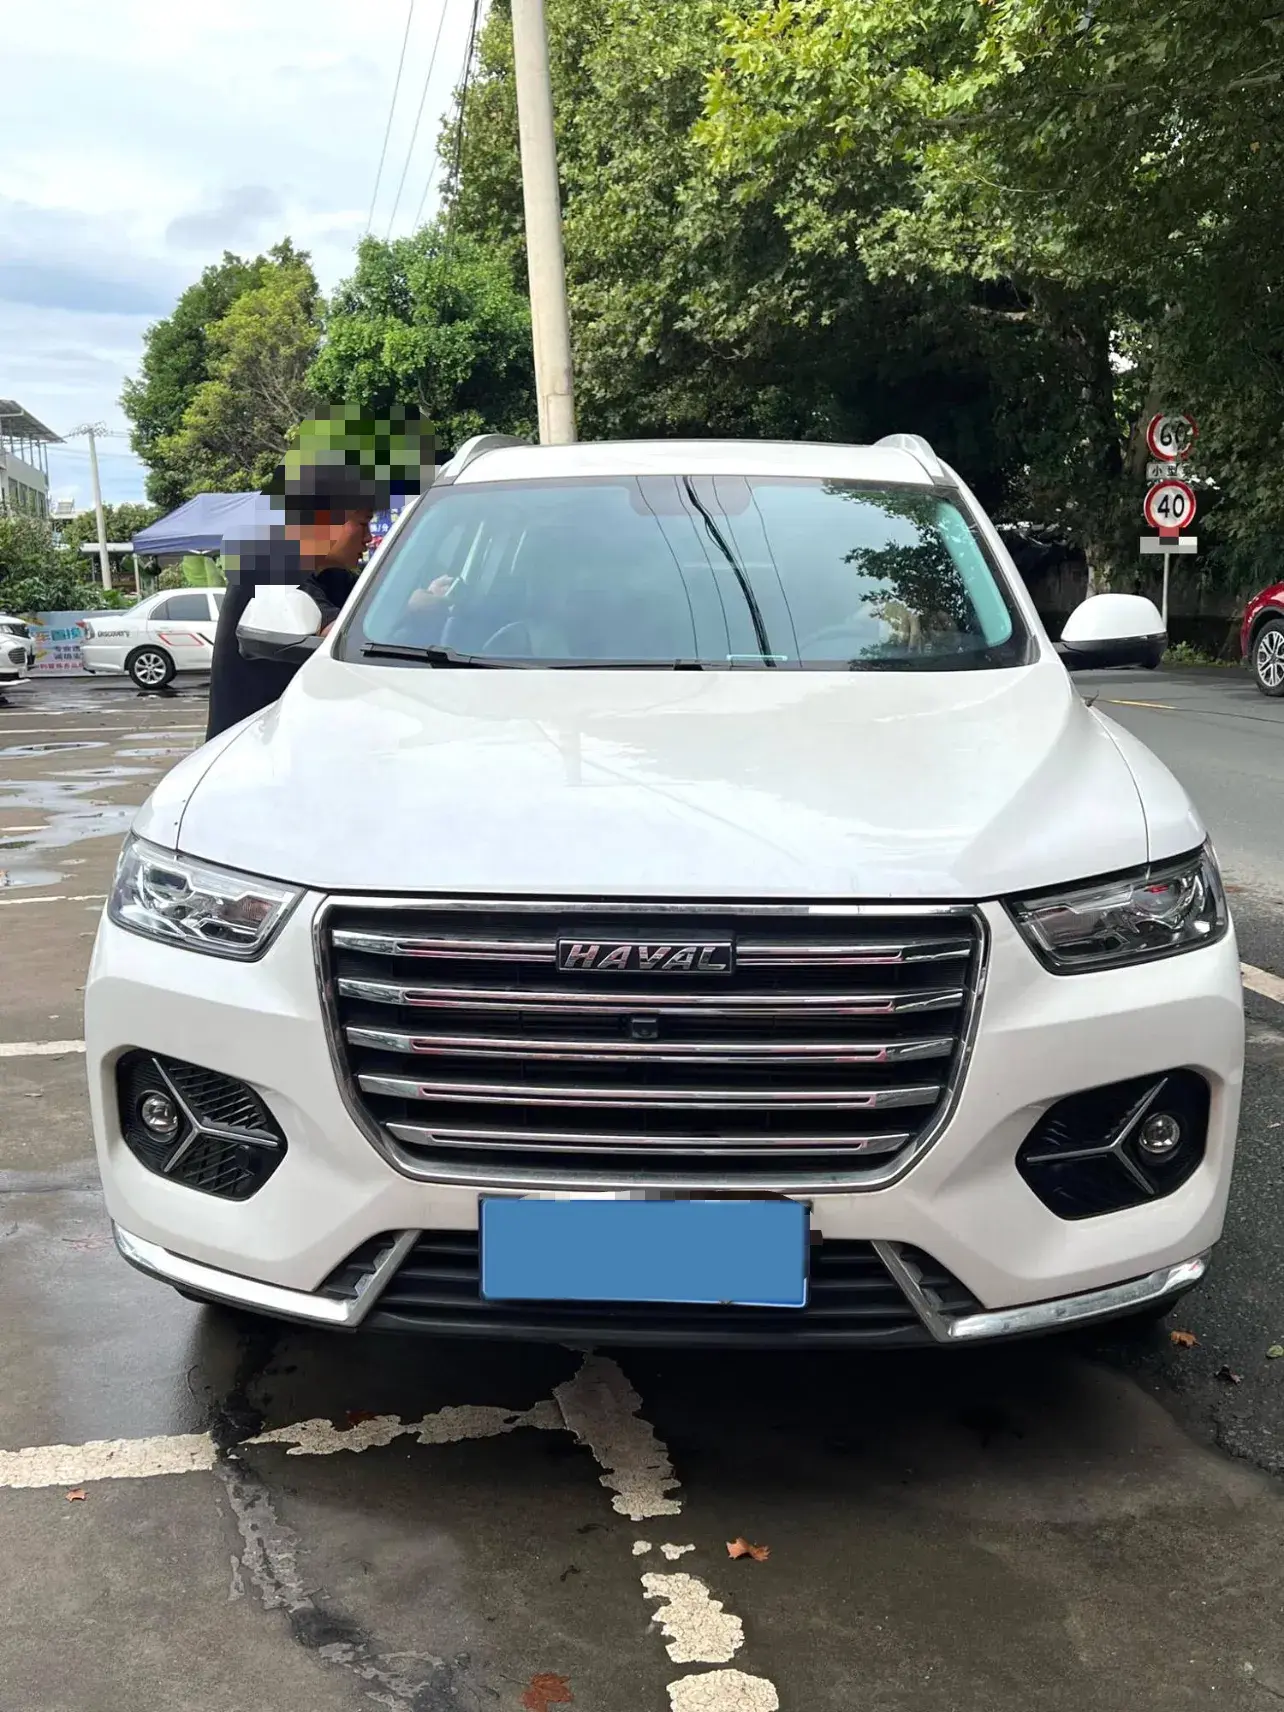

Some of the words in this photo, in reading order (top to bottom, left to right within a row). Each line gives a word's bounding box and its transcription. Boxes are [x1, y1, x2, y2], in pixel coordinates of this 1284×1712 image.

[1152, 465, 1181, 477] 小型
[1157, 494, 1185, 519] 40
[564, 944, 727, 970] HAVAL
